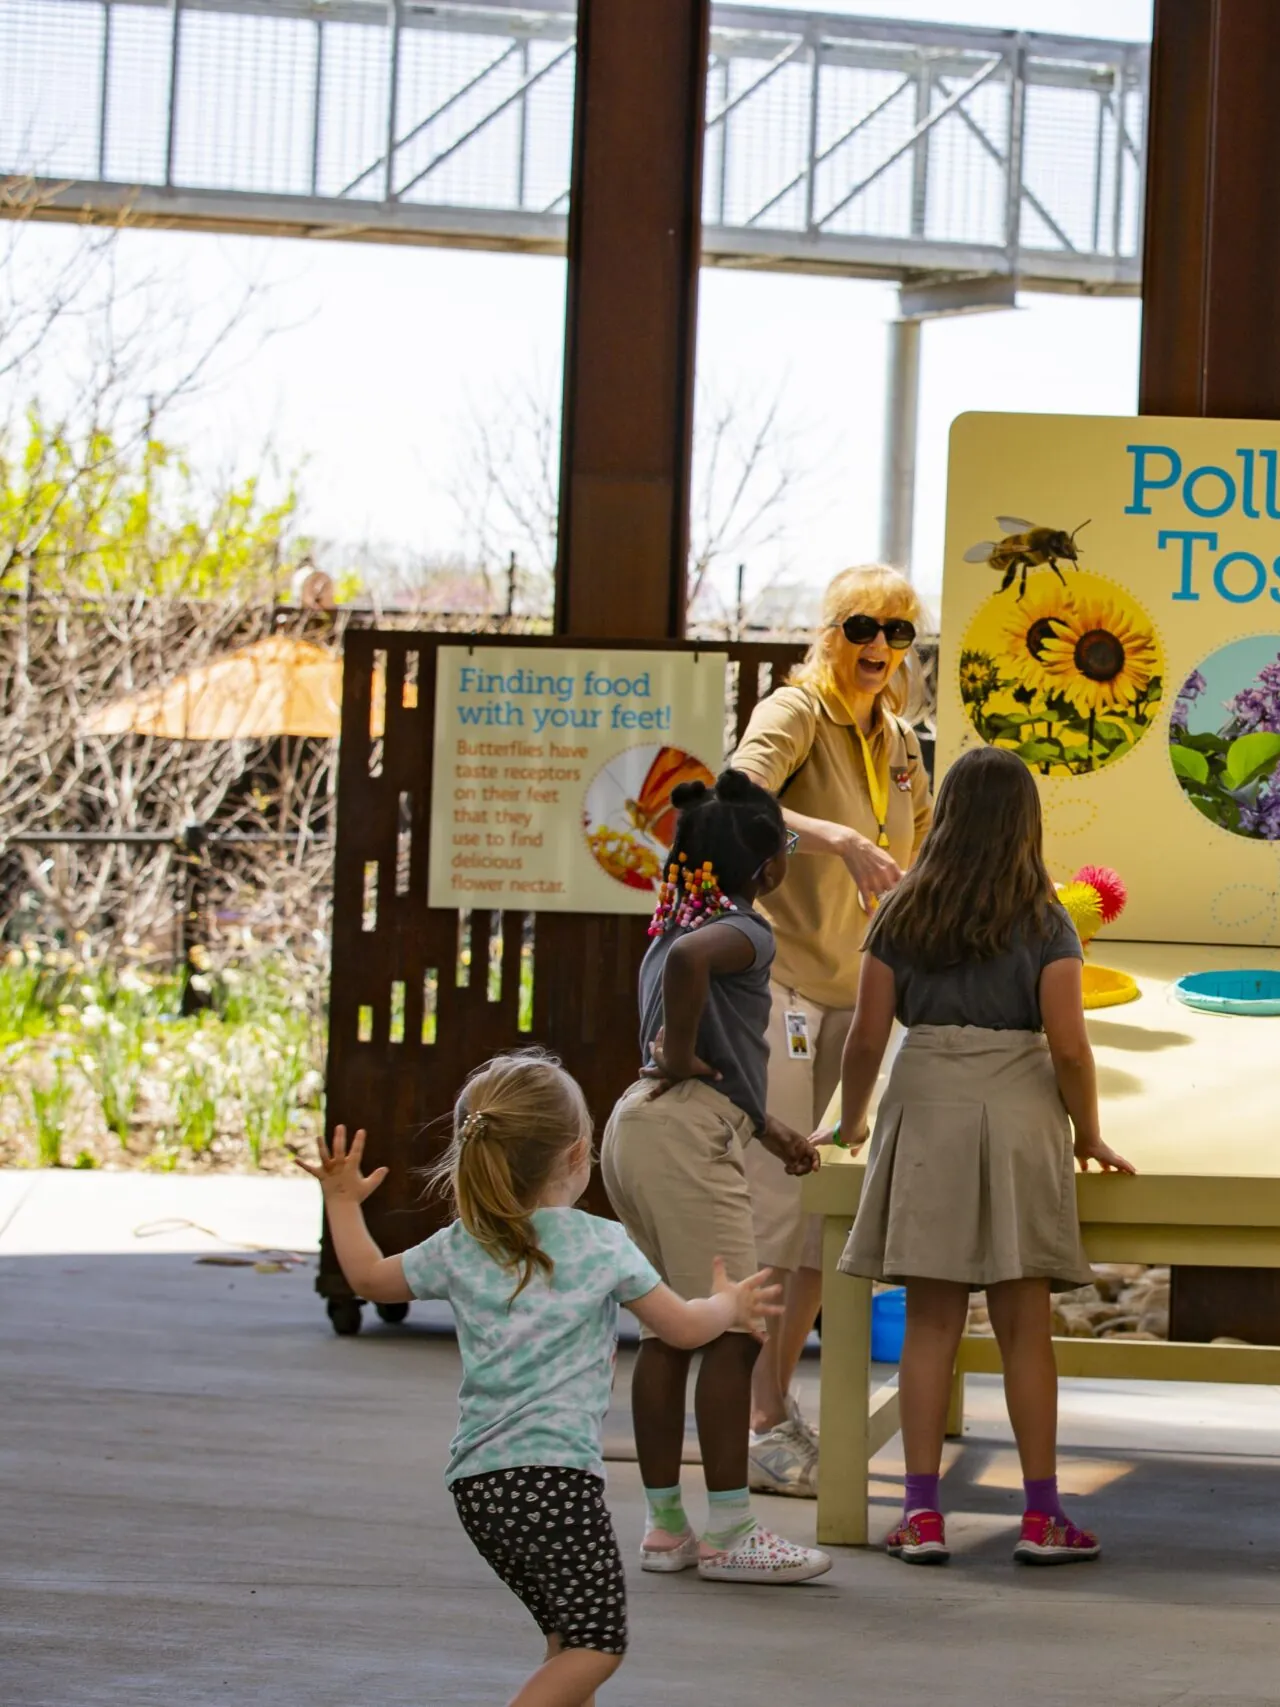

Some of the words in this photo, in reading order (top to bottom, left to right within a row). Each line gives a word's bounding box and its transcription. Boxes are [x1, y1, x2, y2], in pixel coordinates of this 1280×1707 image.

[458, 668, 575, 701] Finding
[583, 670, 651, 697] food
[457, 702, 524, 726] with
[532, 707, 602, 733] your
[611, 704, 671, 729] feet!
[456, 740, 543, 758] Butterflies
[549, 743, 588, 759] have
[455, 764, 497, 780] taste
[504, 765, 580, 785] receptors
[454, 787, 475, 801] on
[482, 785, 520, 801] their
[527, 787, 559, 802] feet
[454, 808, 488, 824] that
[495, 809, 532, 828] they
[453, 832, 480, 846] use
[486, 831, 504, 846] to
[510, 830, 543, 847] find
[452, 853, 523, 870] delicious
[451, 875, 503, 891] flower
[509, 877, 566, 893] nectar.
